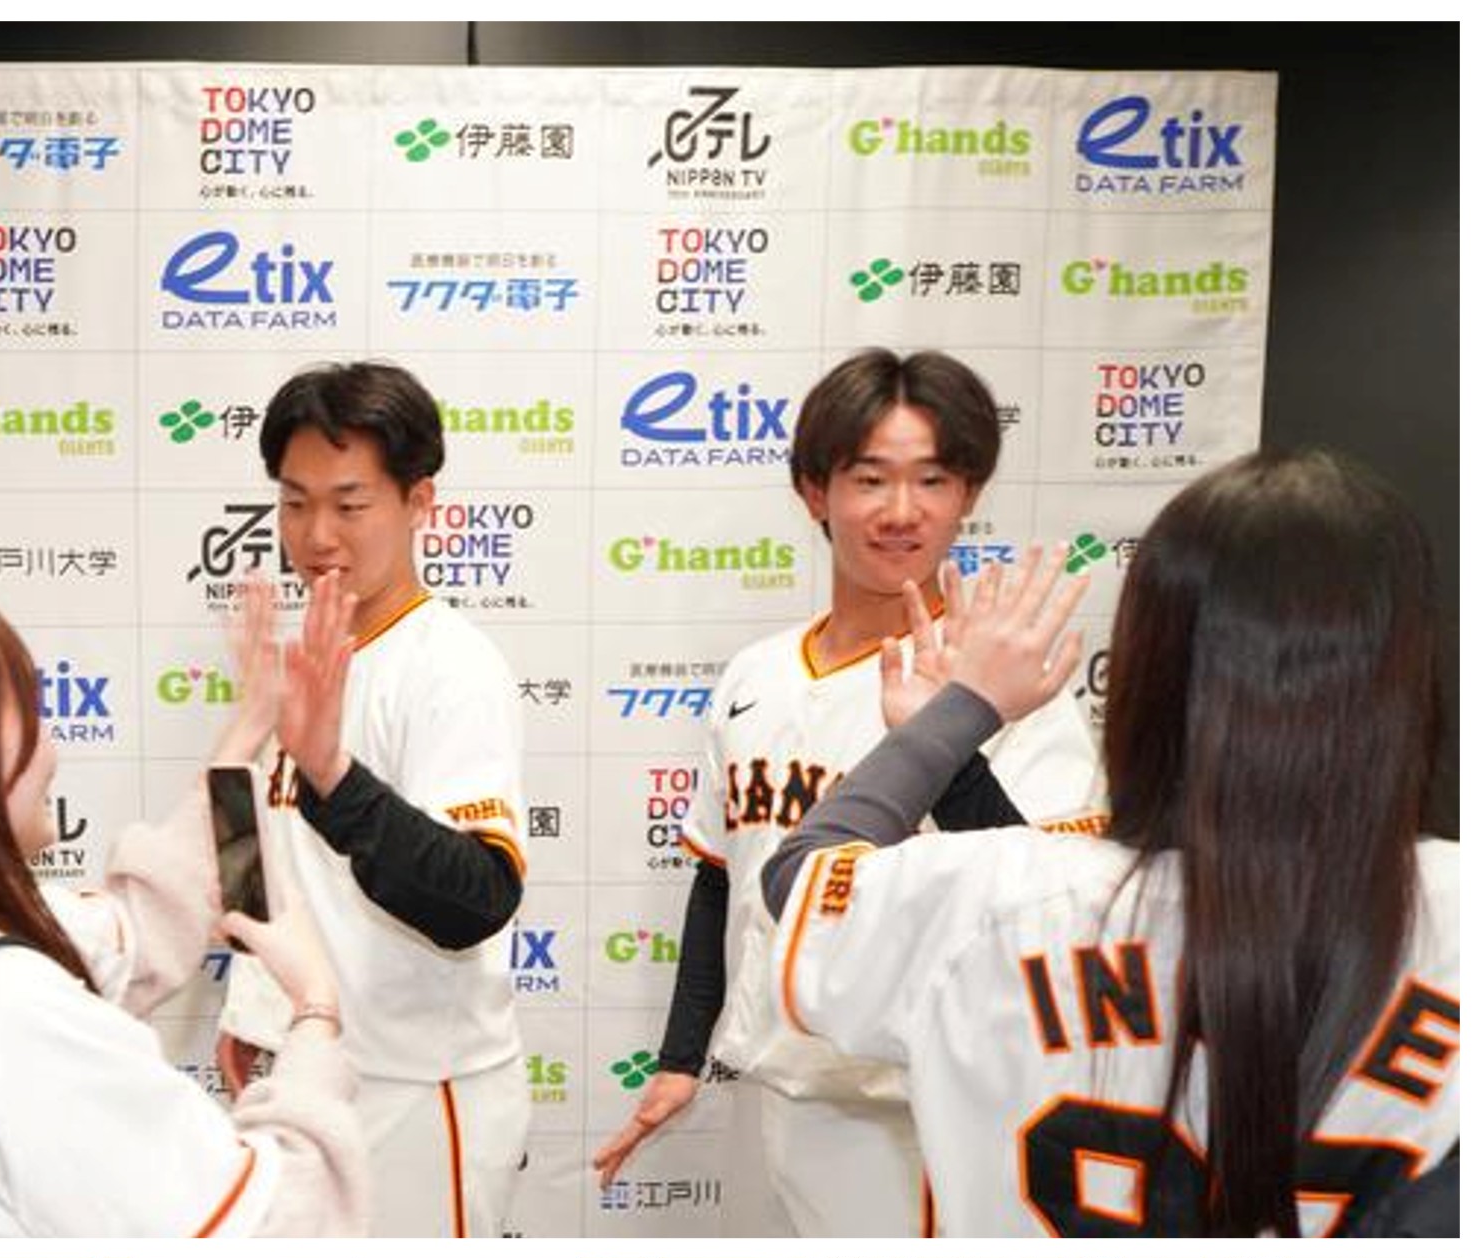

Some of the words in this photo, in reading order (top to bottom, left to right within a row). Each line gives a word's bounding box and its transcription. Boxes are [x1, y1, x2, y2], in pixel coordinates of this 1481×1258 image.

[200, 87, 315, 114] TOKYO
[200, 118, 293, 145] DOME
[455, 122, 575, 159] 伊藤園
[1076, 95, 1242, 169] etix
[200, 149, 292, 175] CITY
[743, 169, 766, 186] TV
[1076, 174, 1152, 194] DATA
[1159, 173, 1245, 195] FARM
[657, 228, 769, 254] TOKYO
[161, 231, 335, 305] etix
[657, 258, 747, 284] DOME
[909, 261, 1021, 296] 伊藤園
[386, 278, 579, 313] フクダ電子
[656, 288, 745, 314] CITY
[161, 311, 243, 330] DATA
[250, 311, 338, 330] FARM
[1097, 363, 1205, 390] TOKYO
[620, 371, 789, 441] etix
[1096, 393, 1183, 418] DOME
[1095, 422, 1182, 448] CITY
[620, 447, 705, 467] DATA
[710, 447, 790, 466] FARM
[426, 504, 534, 529] TOKYO
[423, 533, 513, 558] DOME
[423, 562, 511, 588] CITY
[51, 724, 114, 742] ARM
